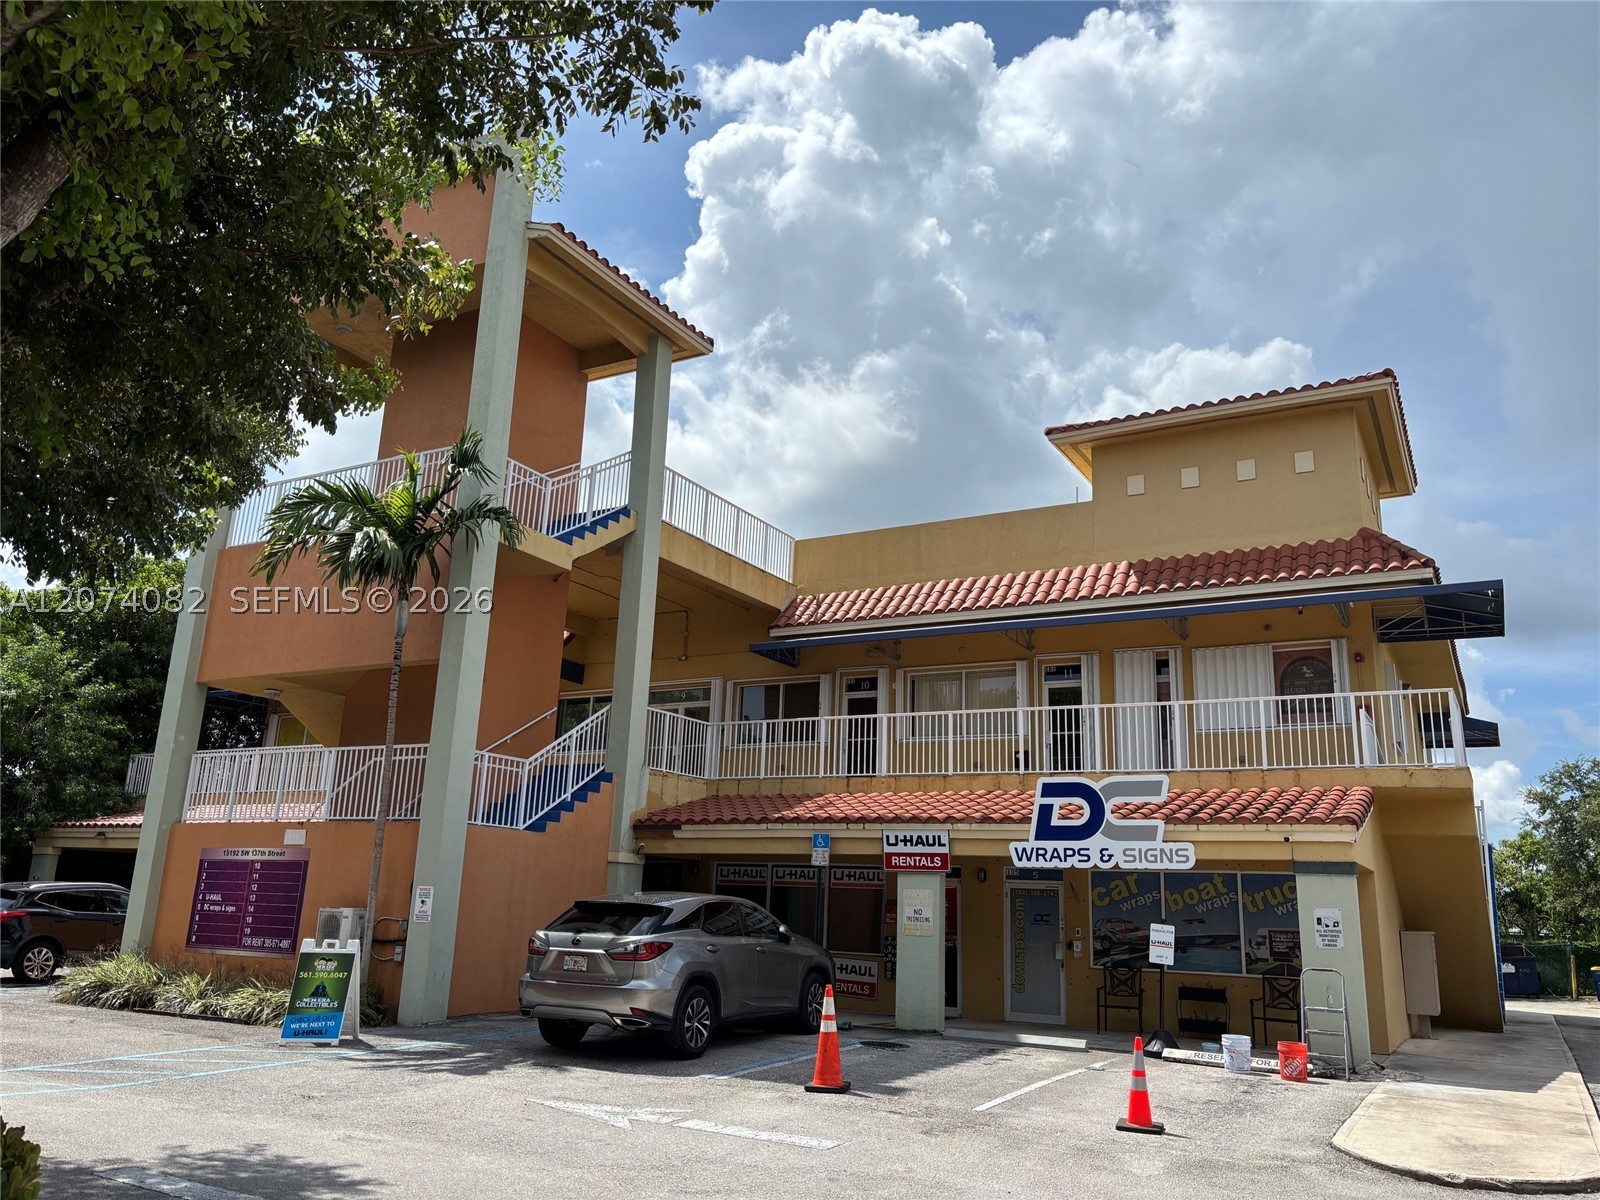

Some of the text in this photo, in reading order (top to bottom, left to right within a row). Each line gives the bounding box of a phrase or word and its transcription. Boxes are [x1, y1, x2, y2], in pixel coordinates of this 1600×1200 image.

[861, 681, 870, 690] 10
[1284, 687, 1306, 695] RUGS
[681, 691, 686, 701] 9
[1034, 780, 1164, 842] DC
[885, 834, 947, 848] U-HAUL
[251, 849, 266, 857] 137th
[1014, 847, 1190, 864] WRAPS & SIGNS
[254, 862, 260, 870] 10
[891, 856, 942, 867] RENTALS
[720, 868, 766, 879] U-HAUL
[833, 871, 884, 882] U-HAUL
[1033, 871, 1039, 879] 5
[1092, 873, 1139, 907] car
[1165, 873, 1228, 912] boat
[205, 893, 222, 901] U-HAUL
[1120, 890, 1160, 912] wraps
[1243, 881, 1297, 914] truc
[1195, 892, 1237, 914] wraps
[913, 908, 923, 916] NO
[905, 915, 931, 924] TRESPASSING
[242, 937, 252, 946] FOR
[252, 937, 264, 947] RENT
[1151, 939, 1173, 947] U-HAUL
[299, 971, 348, 979] 561.590.6047
[837, 963, 876, 977] -HAUL
[835, 982, 870, 994] ENTALS
[1284, 1056, 1302, 1076] HOME
